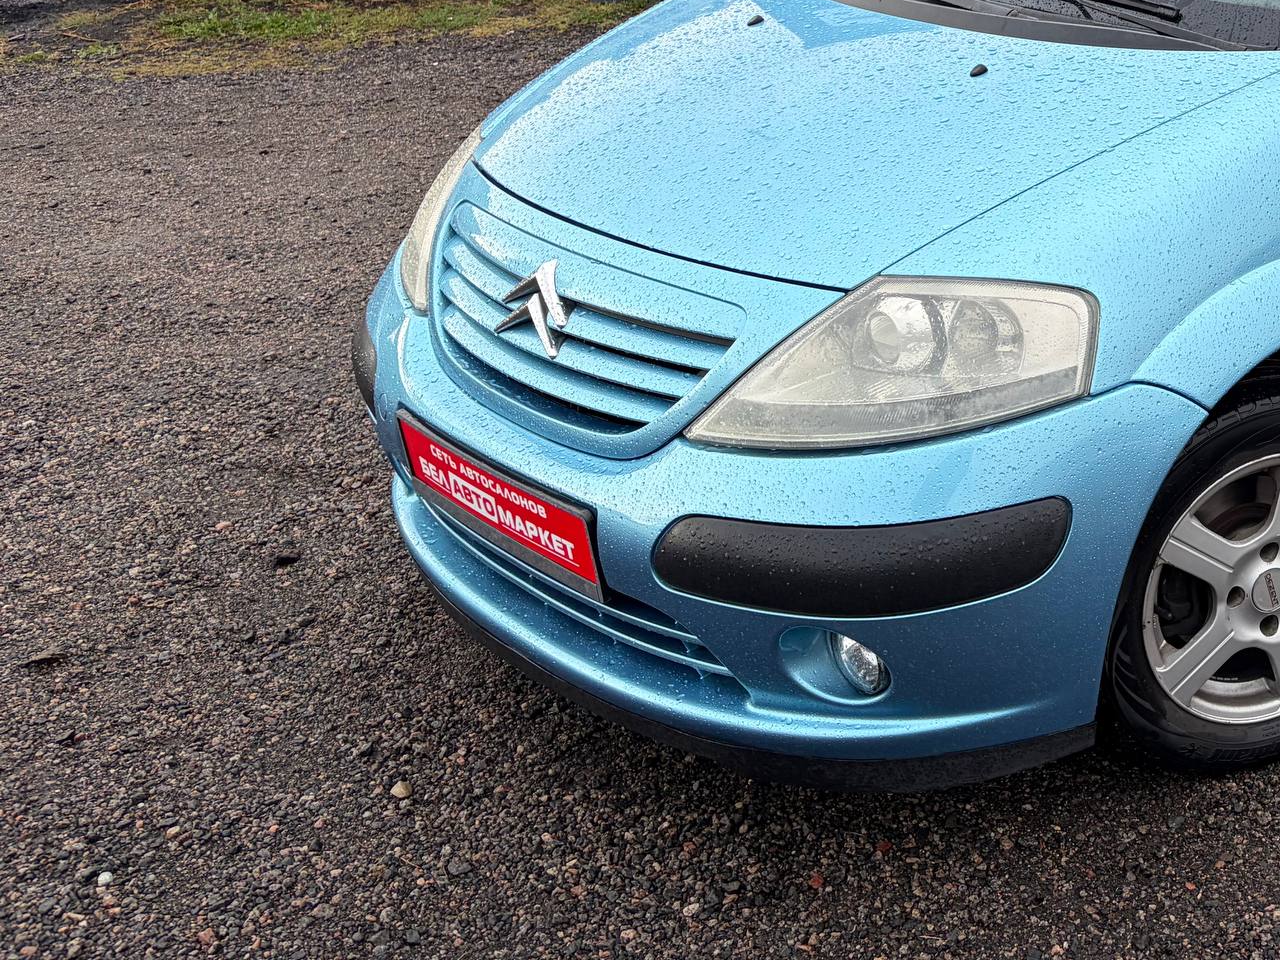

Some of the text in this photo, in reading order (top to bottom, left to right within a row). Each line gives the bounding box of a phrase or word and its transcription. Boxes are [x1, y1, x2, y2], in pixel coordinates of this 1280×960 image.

[418, 455, 575, 560] БЕЛ АВТО МАРКЕТ
[429, 444, 547, 518] СЕТЬ АВТОСАЛОНОВ
